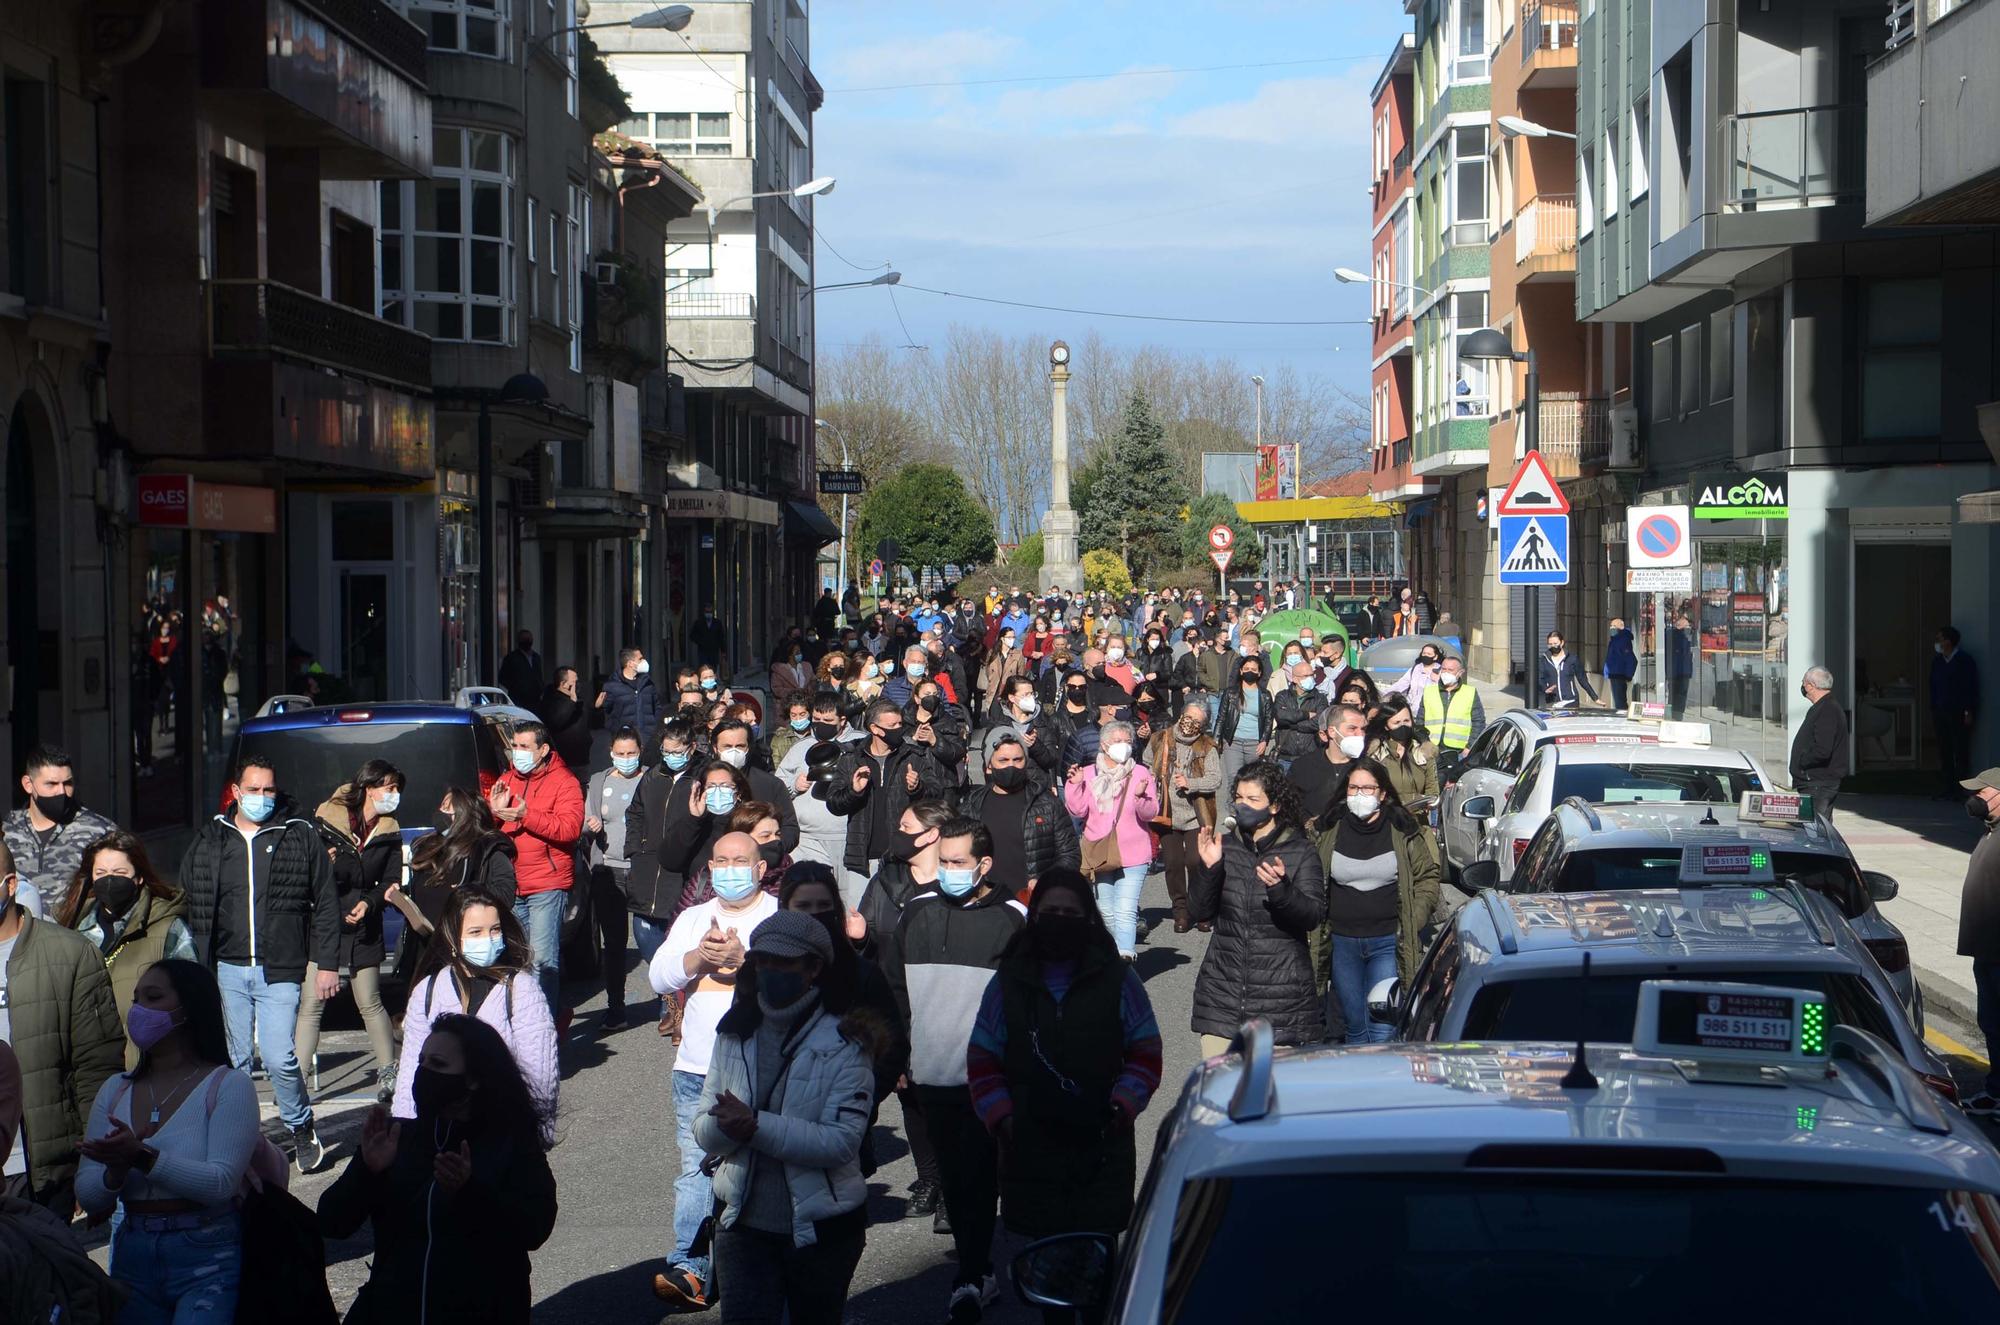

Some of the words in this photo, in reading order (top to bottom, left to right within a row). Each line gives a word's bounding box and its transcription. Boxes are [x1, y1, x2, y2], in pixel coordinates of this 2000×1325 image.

[824, 482, 860, 492] BARRANTES
[142, 490, 186, 504] GAES
[1728, 997, 1785, 1007] RADIOTAXI
[1703, 1019, 1728, 1032] 986
[1733, 1021, 1756, 1034] 511
[1762, 1023, 1785, 1035] 511
[1702, 1038, 1741, 1047] SERVICIO
[1743, 1040, 1753, 1048] 24
[1755, 1041, 1786, 1050] HORAS
[1928, 1202, 1977, 1233] 14
